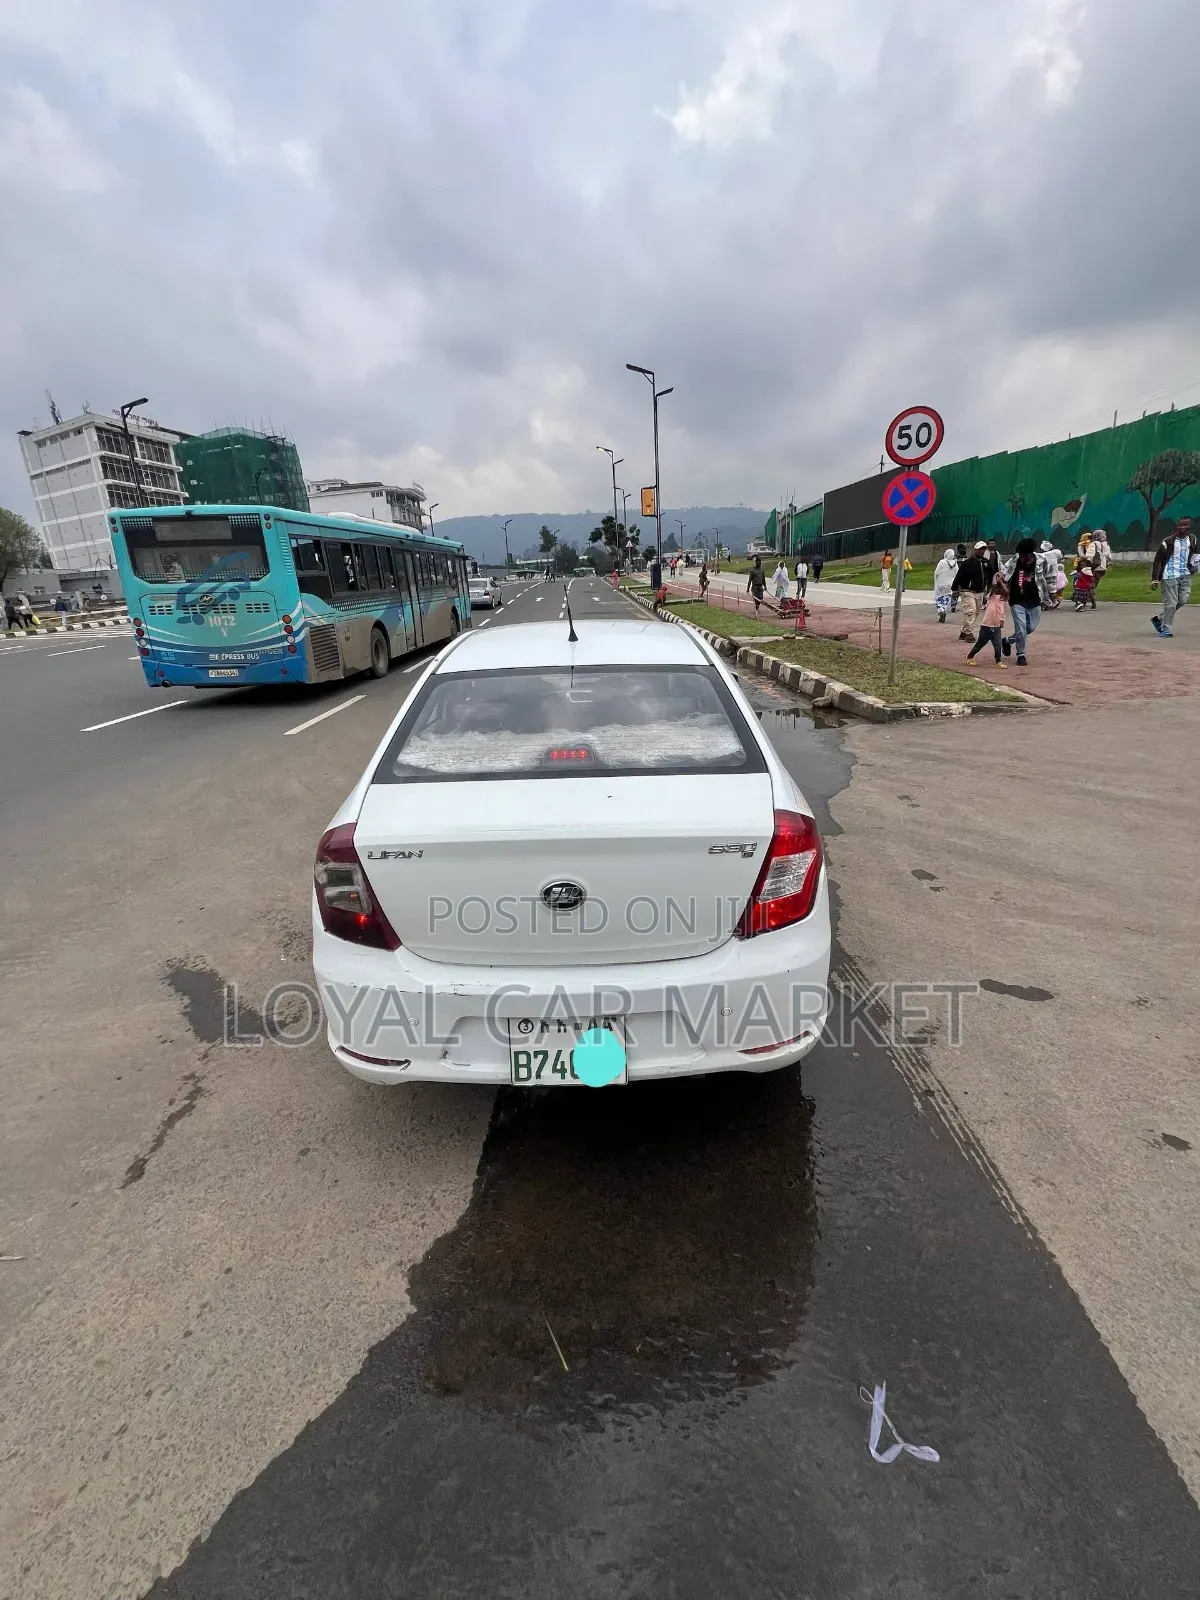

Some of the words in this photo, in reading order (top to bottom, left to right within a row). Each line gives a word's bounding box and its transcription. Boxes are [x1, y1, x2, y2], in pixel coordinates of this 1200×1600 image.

[897, 422, 932, 450] 50
[207, 615, 237, 627] 1072
[246, 652, 260, 660] BUS
[367, 849, 424, 860] LIFAN
